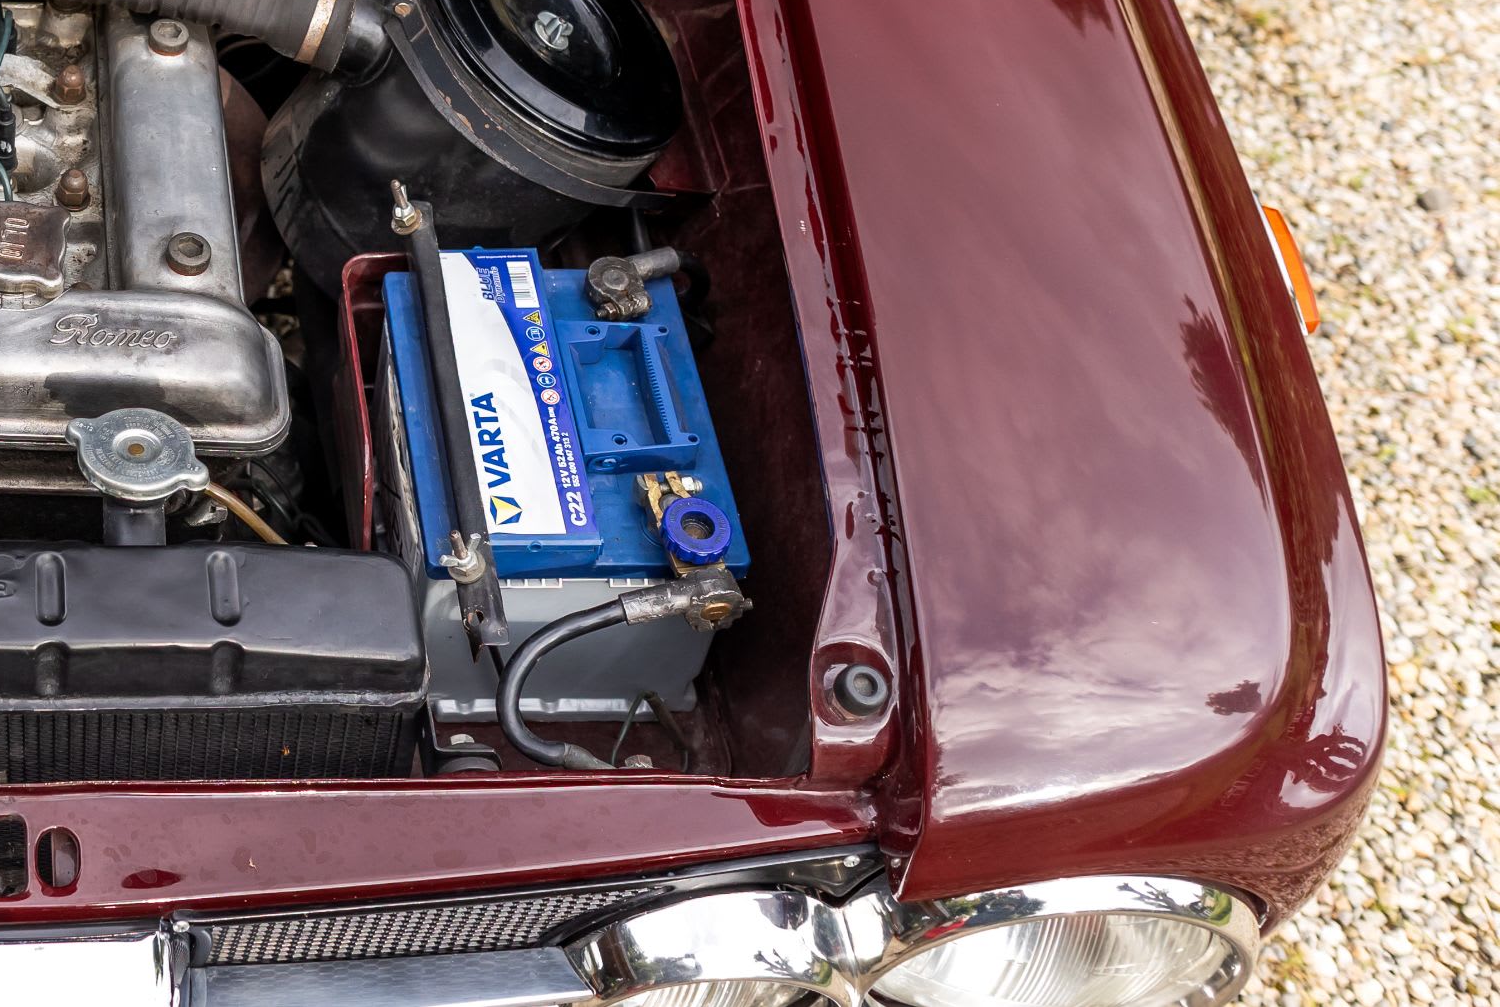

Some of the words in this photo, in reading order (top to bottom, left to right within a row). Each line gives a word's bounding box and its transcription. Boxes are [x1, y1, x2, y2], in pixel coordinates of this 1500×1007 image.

[476, 267, 495, 301] BLUE
[489, 266, 506, 303] Dynamic
[50, 313, 178, 348] Romeo
[471, 392, 511, 489] VARTA
[560, 470, 571, 489] 12V
[571, 474, 581, 488] 552
[566, 491, 587, 526] C22
